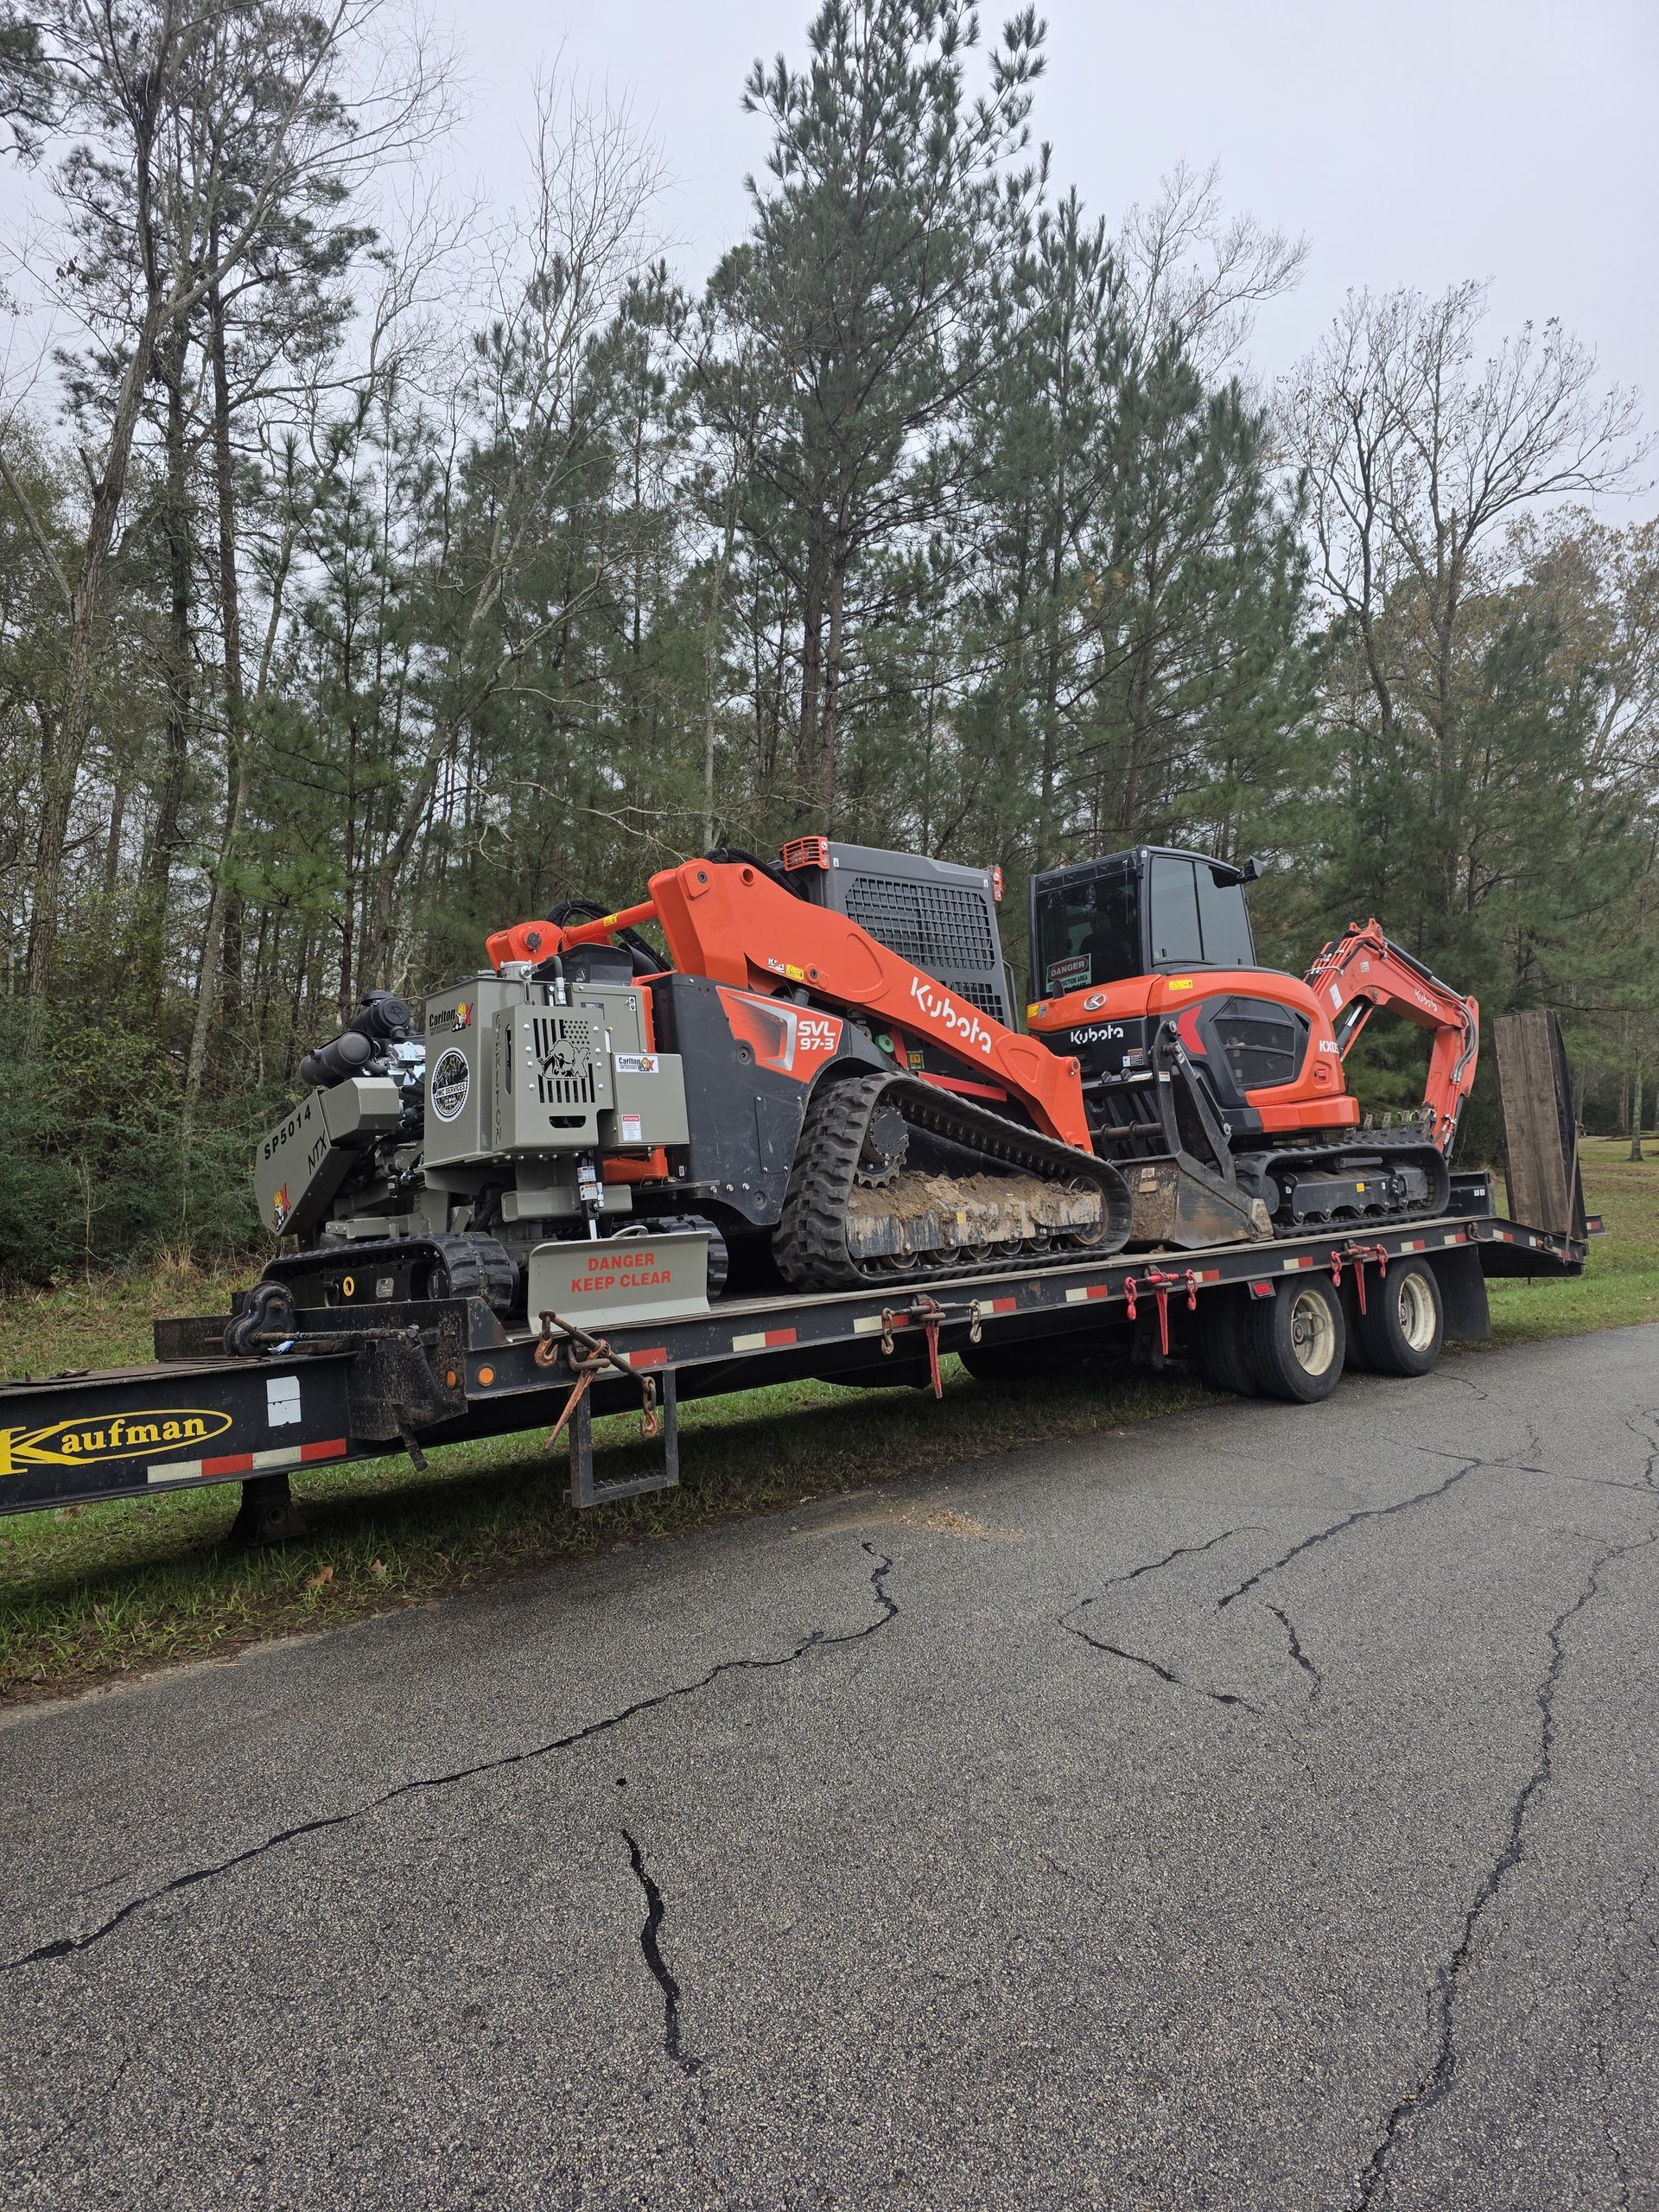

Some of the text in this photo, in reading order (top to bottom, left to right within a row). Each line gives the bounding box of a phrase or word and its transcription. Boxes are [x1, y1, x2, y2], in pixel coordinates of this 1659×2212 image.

[1051, 961, 1085, 977] DANGER
[1414, 988, 1438, 1012] Kubota
[429, 1009, 455, 1027] Carlton
[911, 976, 992, 1053] Kubota
[798, 1020, 836, 1036] SVL
[1071, 1025, 1124, 1045] Kubota
[800, 1038, 834, 1050] 97-3
[619, 1057, 640, 1065] Carlton
[445, 1083, 466, 1094] SERVICES
[264, 1103, 311, 1160] SP5014
[308, 1128, 327, 1176] NTX
[588, 1253, 654, 1272] DANGER
[571, 1270, 671, 1293] KEEP CLEAR
[0, 1418, 207, 1476] Kaufman
